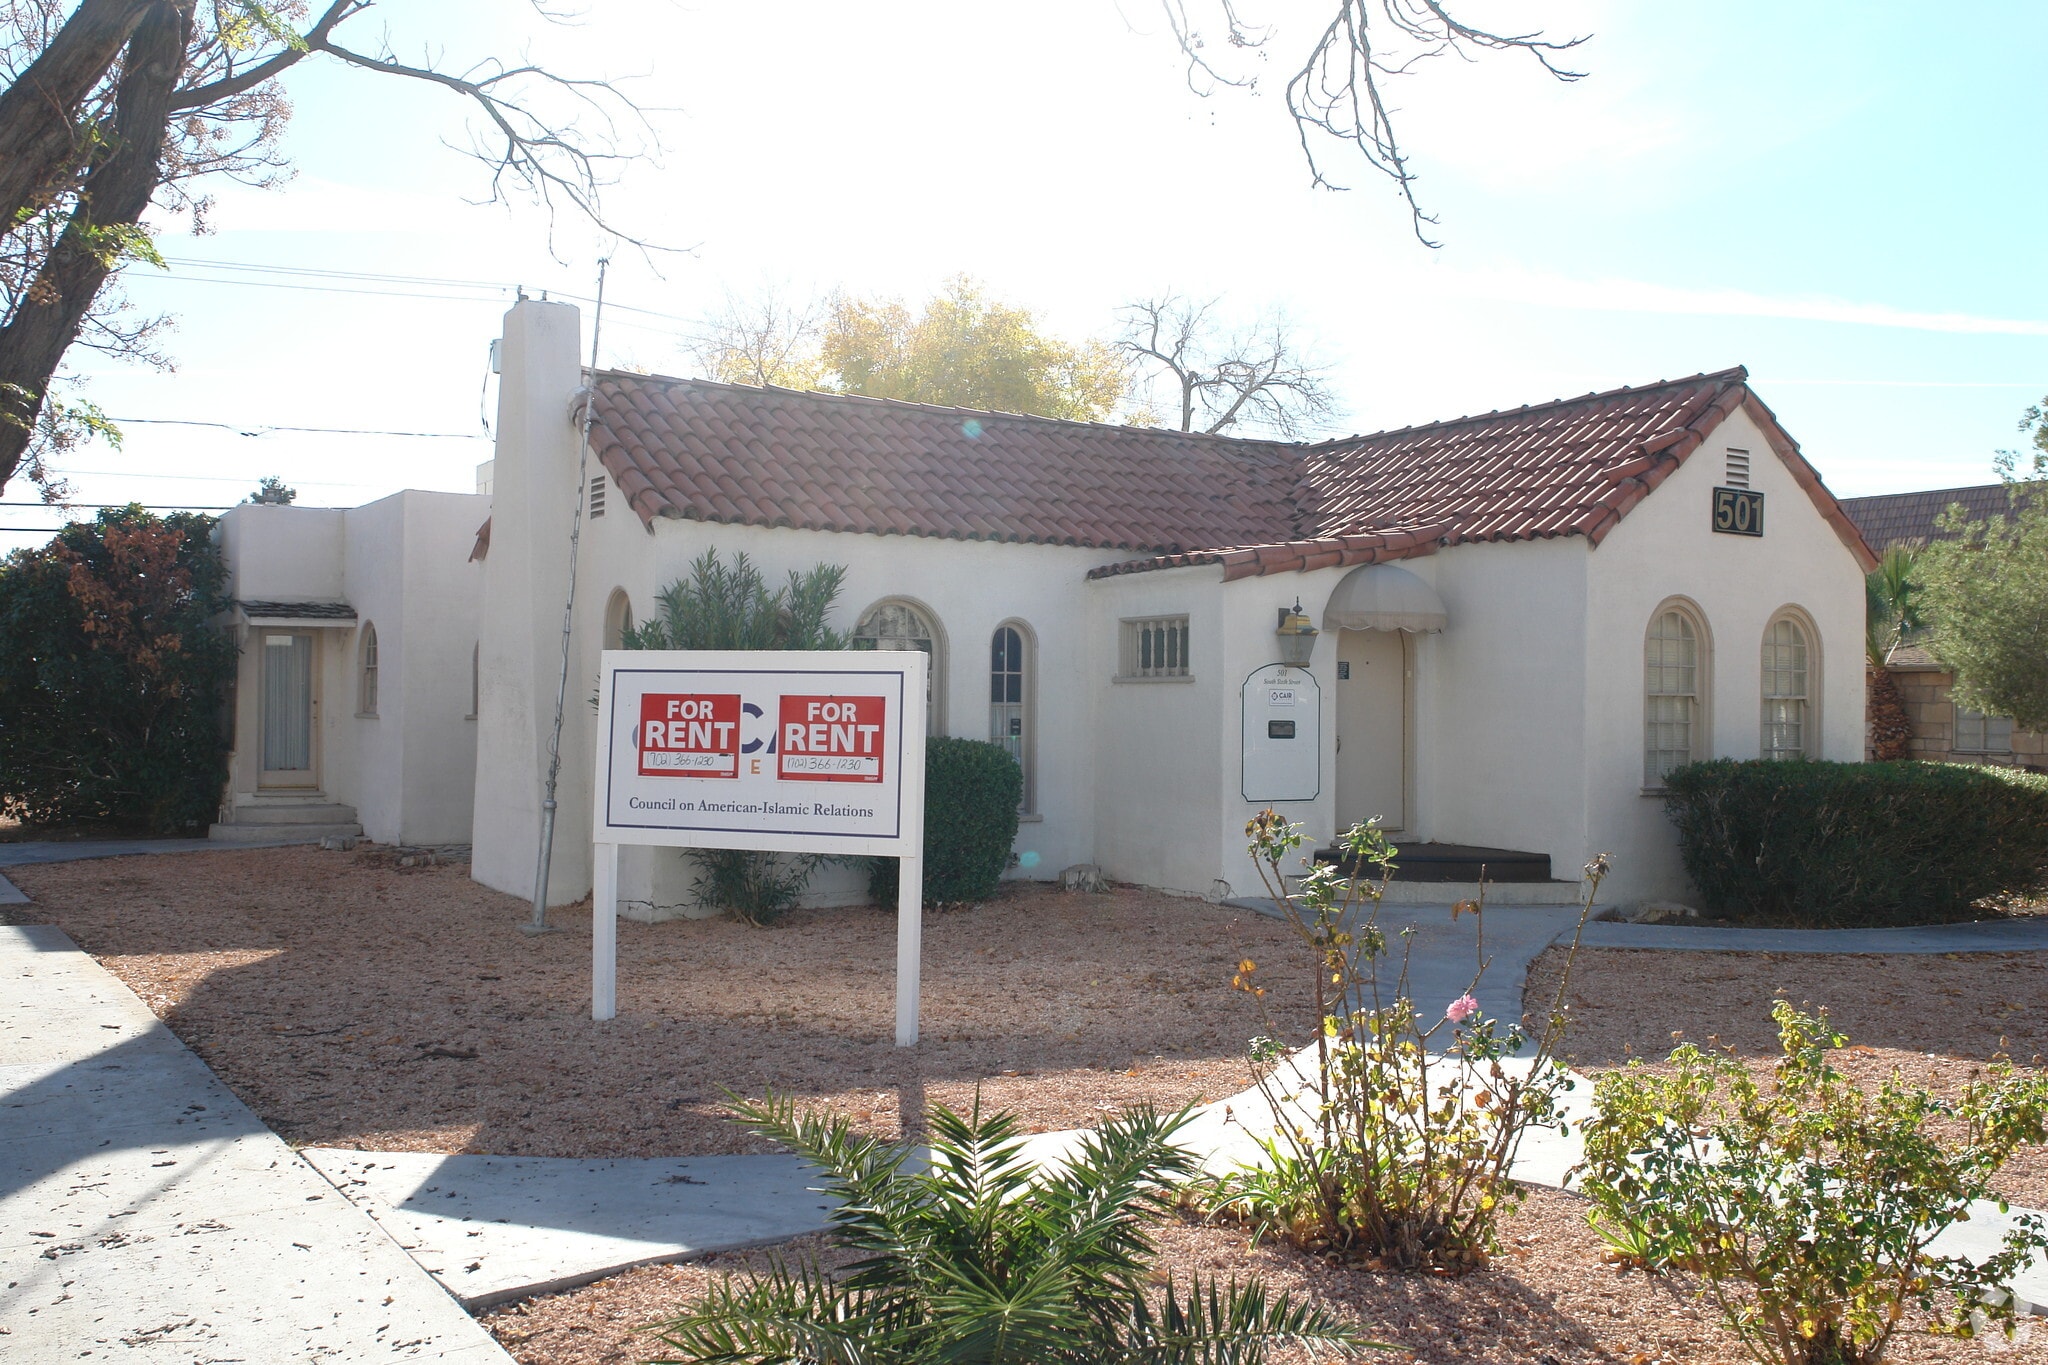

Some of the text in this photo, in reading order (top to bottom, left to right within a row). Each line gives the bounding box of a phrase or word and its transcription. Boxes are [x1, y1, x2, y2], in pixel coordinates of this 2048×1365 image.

[1717, 493, 1761, 532] 501
[667, 700, 714, 720] FOR
[807, 702, 857, 722] FOR
[645, 720, 735, 750] RENT
[784, 723, 880, 753] RENT
[808, 757, 861, 771] 366-1230
[629, 796, 874, 817] Council on American-Islamic Relations
